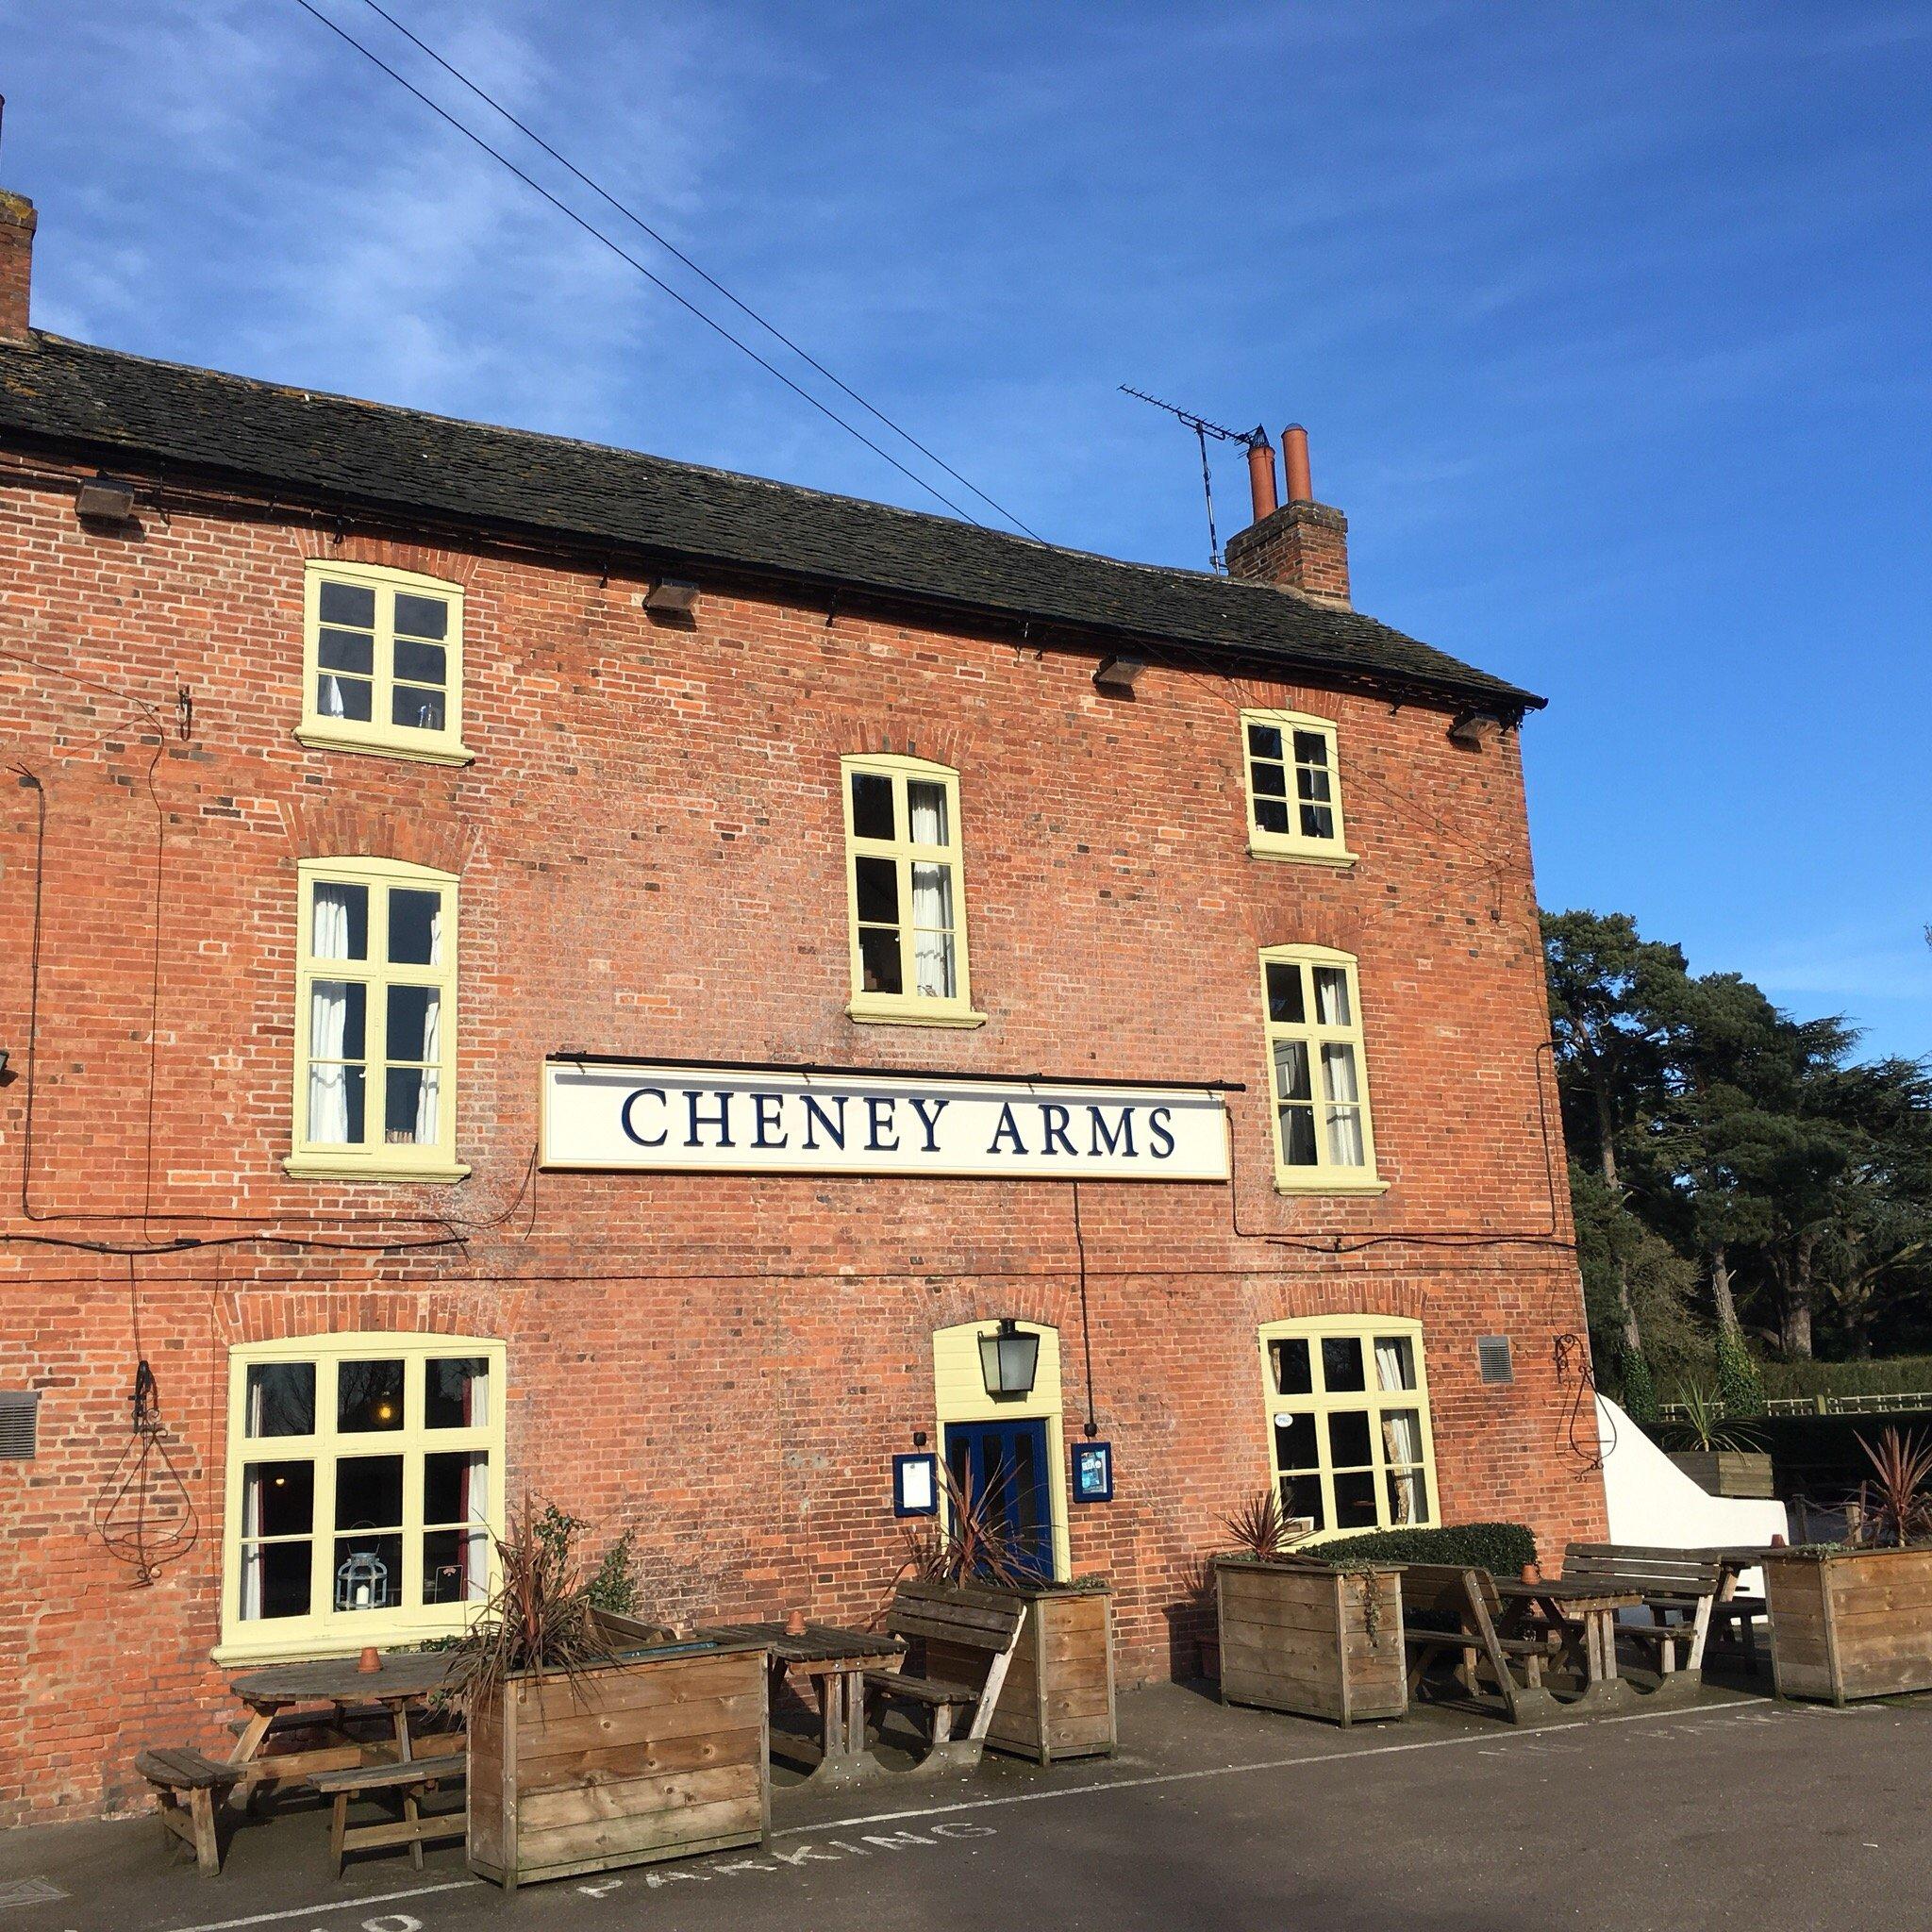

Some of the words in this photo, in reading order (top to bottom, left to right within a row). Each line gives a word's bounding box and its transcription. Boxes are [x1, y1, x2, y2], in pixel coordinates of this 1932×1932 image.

[620, 1088, 949, 1153] CHENEY
[987, 1102, 1175, 1159] ARMS
[576, 1822, 998, 1898] PARKING
